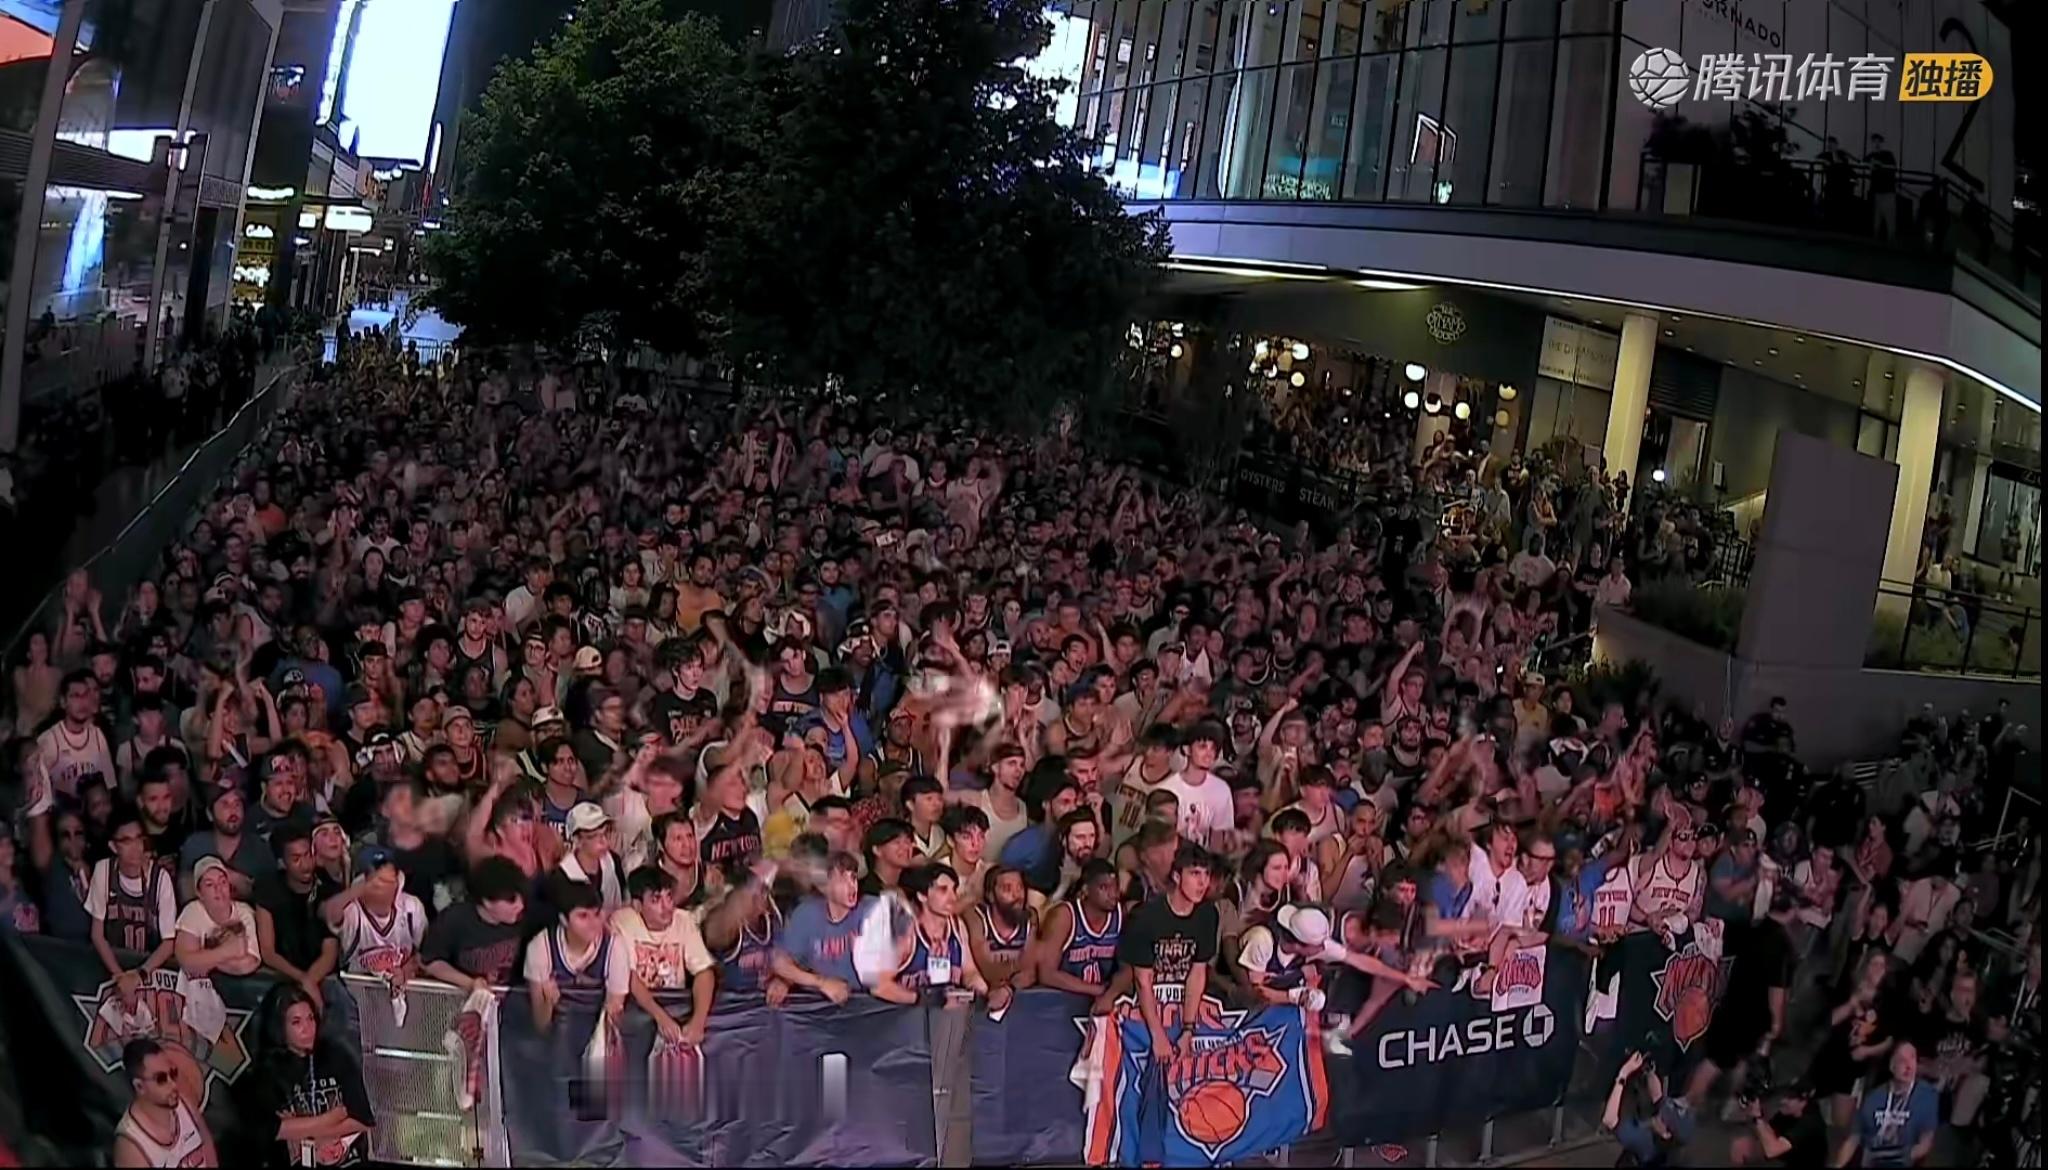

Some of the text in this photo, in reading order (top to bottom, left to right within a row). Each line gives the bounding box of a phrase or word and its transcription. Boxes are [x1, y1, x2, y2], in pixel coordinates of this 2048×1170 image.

[1240, 469, 1286, 494] OYSTERS
[124, 924, 145, 953] 11
[1378, 1014, 1516, 1069] CHASE
